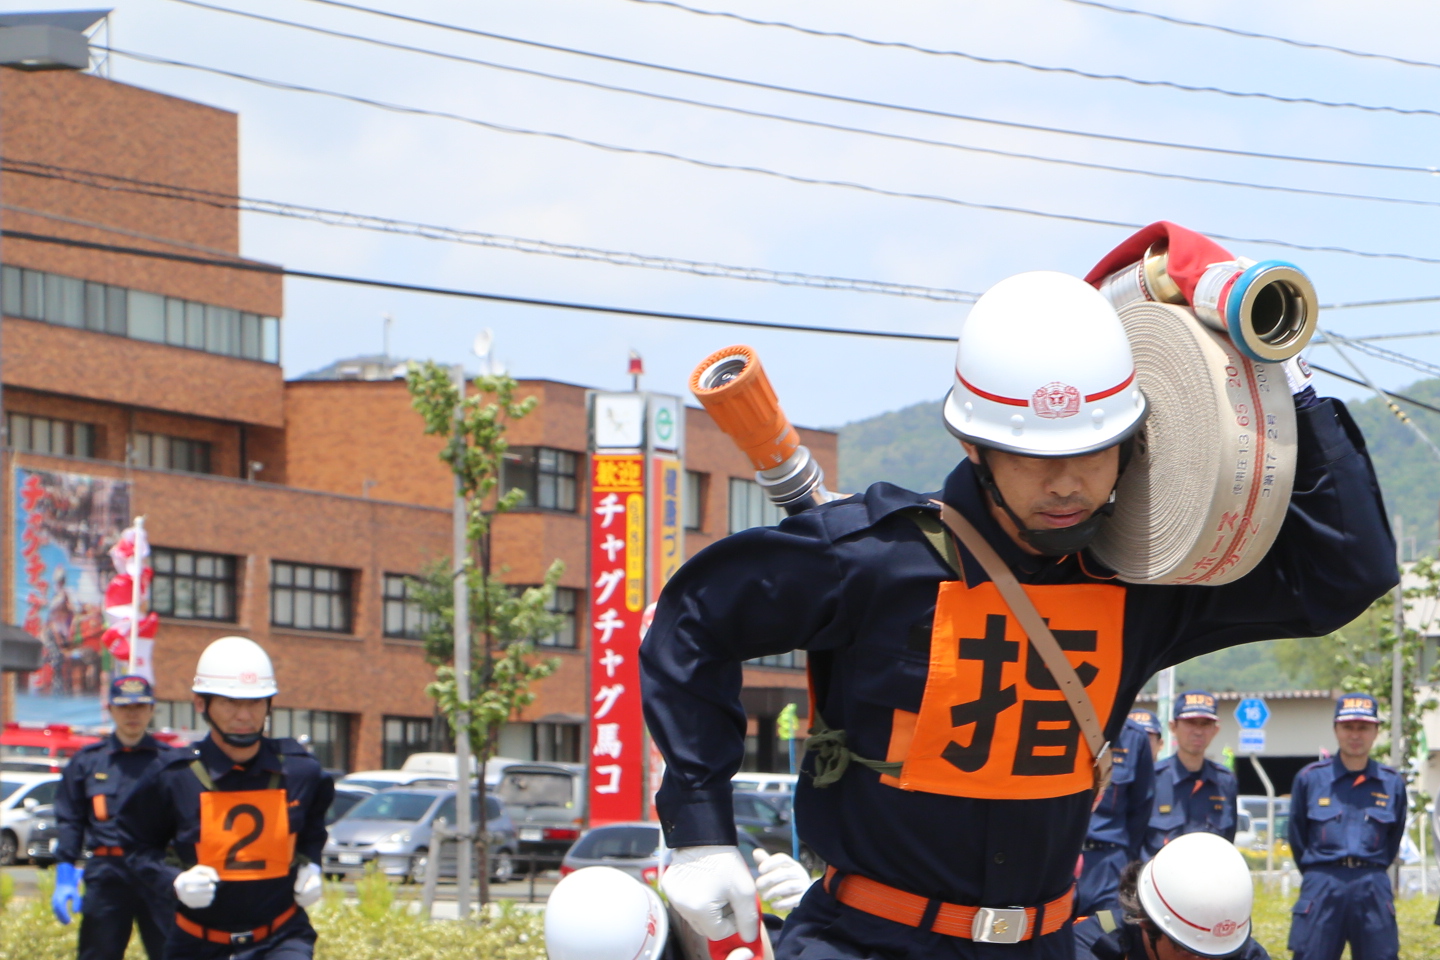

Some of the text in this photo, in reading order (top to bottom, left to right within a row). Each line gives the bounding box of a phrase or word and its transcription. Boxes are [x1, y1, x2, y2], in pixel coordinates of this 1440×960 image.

[1236, 403, 1250, 427] 65
[595, 460, 642, 487] 歓迎
[1171, 510, 1240, 585] トホース
[592, 492, 626, 795] チャグチャグ馬コ
[940, 613, 1100, 777] 指
[223, 803, 267, 870] 2
